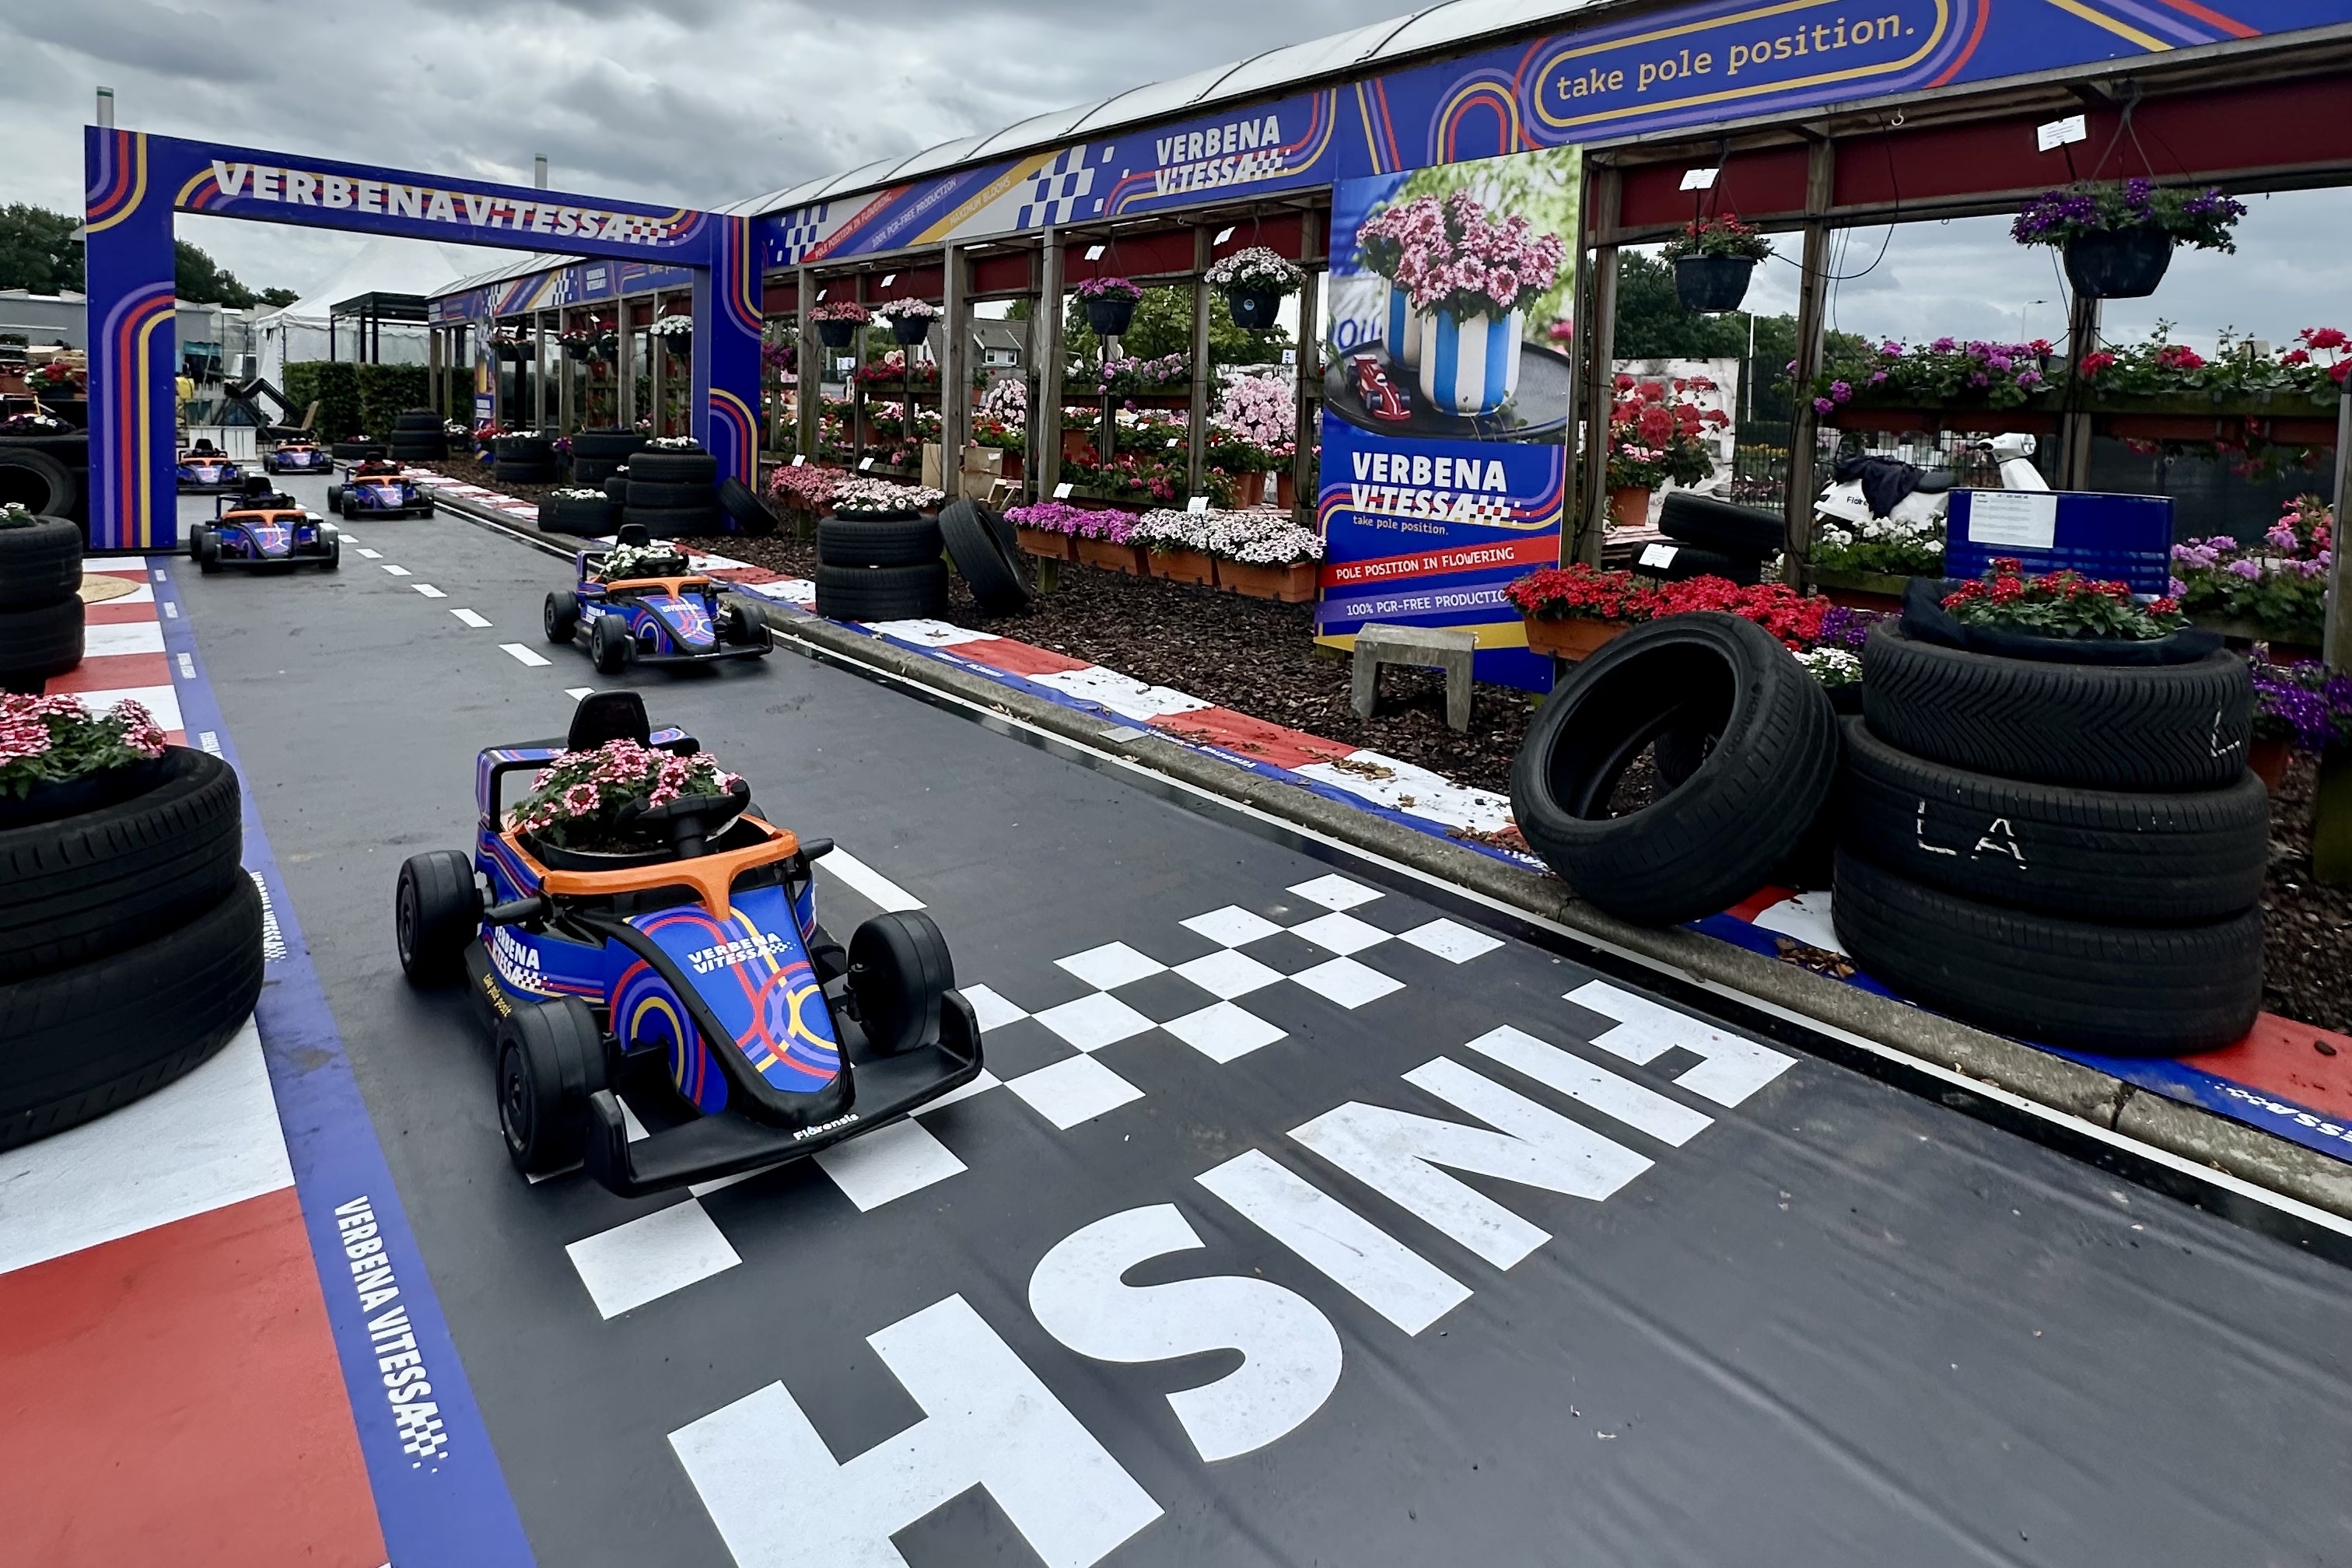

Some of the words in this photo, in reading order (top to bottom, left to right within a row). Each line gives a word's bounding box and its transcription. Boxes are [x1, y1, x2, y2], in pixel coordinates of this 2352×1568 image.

[1556, 68, 1624, 100] take
[1637, 50, 1713, 93] pole
[1727, 13, 1915, 75] position.
[1156, 115, 1281, 166] VERBENA
[1155, 153, 1256, 196] VITESSA
[208, 159, 457, 223] VERBENA
[464, 194, 634, 243] VITESSA
[916, 177, 957, 215] PRODUCTION
[949, 198, 982, 227] MAXIMUM
[982, 176, 1011, 202] BLOOMS
[815, 242, 828, 258] POLE
[828, 225, 854, 244] POSITION
[1352, 452, 1507, 493] VERBENA
[1351, 483, 1473, 523] VITESSA
[1353, 515, 1374, 527] take
[1377, 518, 1398, 530] pole
[1401, 522, 1450, 536] position.
[1336, 567, 1362, 581] POLE
[1365, 560, 1419, 577] POSITION
[1423, 557, 1438, 570] IN
[1442, 547, 1515, 568] FLOWERING
[1346, 603, 1374, 616] 100%
[1377, 597, 1432, 614] PGR-FREE
[1436, 590, 1509, 608] PRODUCTIO
[495, 926, 541, 971] VERBENA
[688, 933, 782, 964] VERBENA
[692, 945, 771, 975] VITESSA
[667, 978, 1798, 1568] FINISH
[334, 1195, 400, 1313] VERBENA
[368, 1304, 439, 1428] VITESSA
